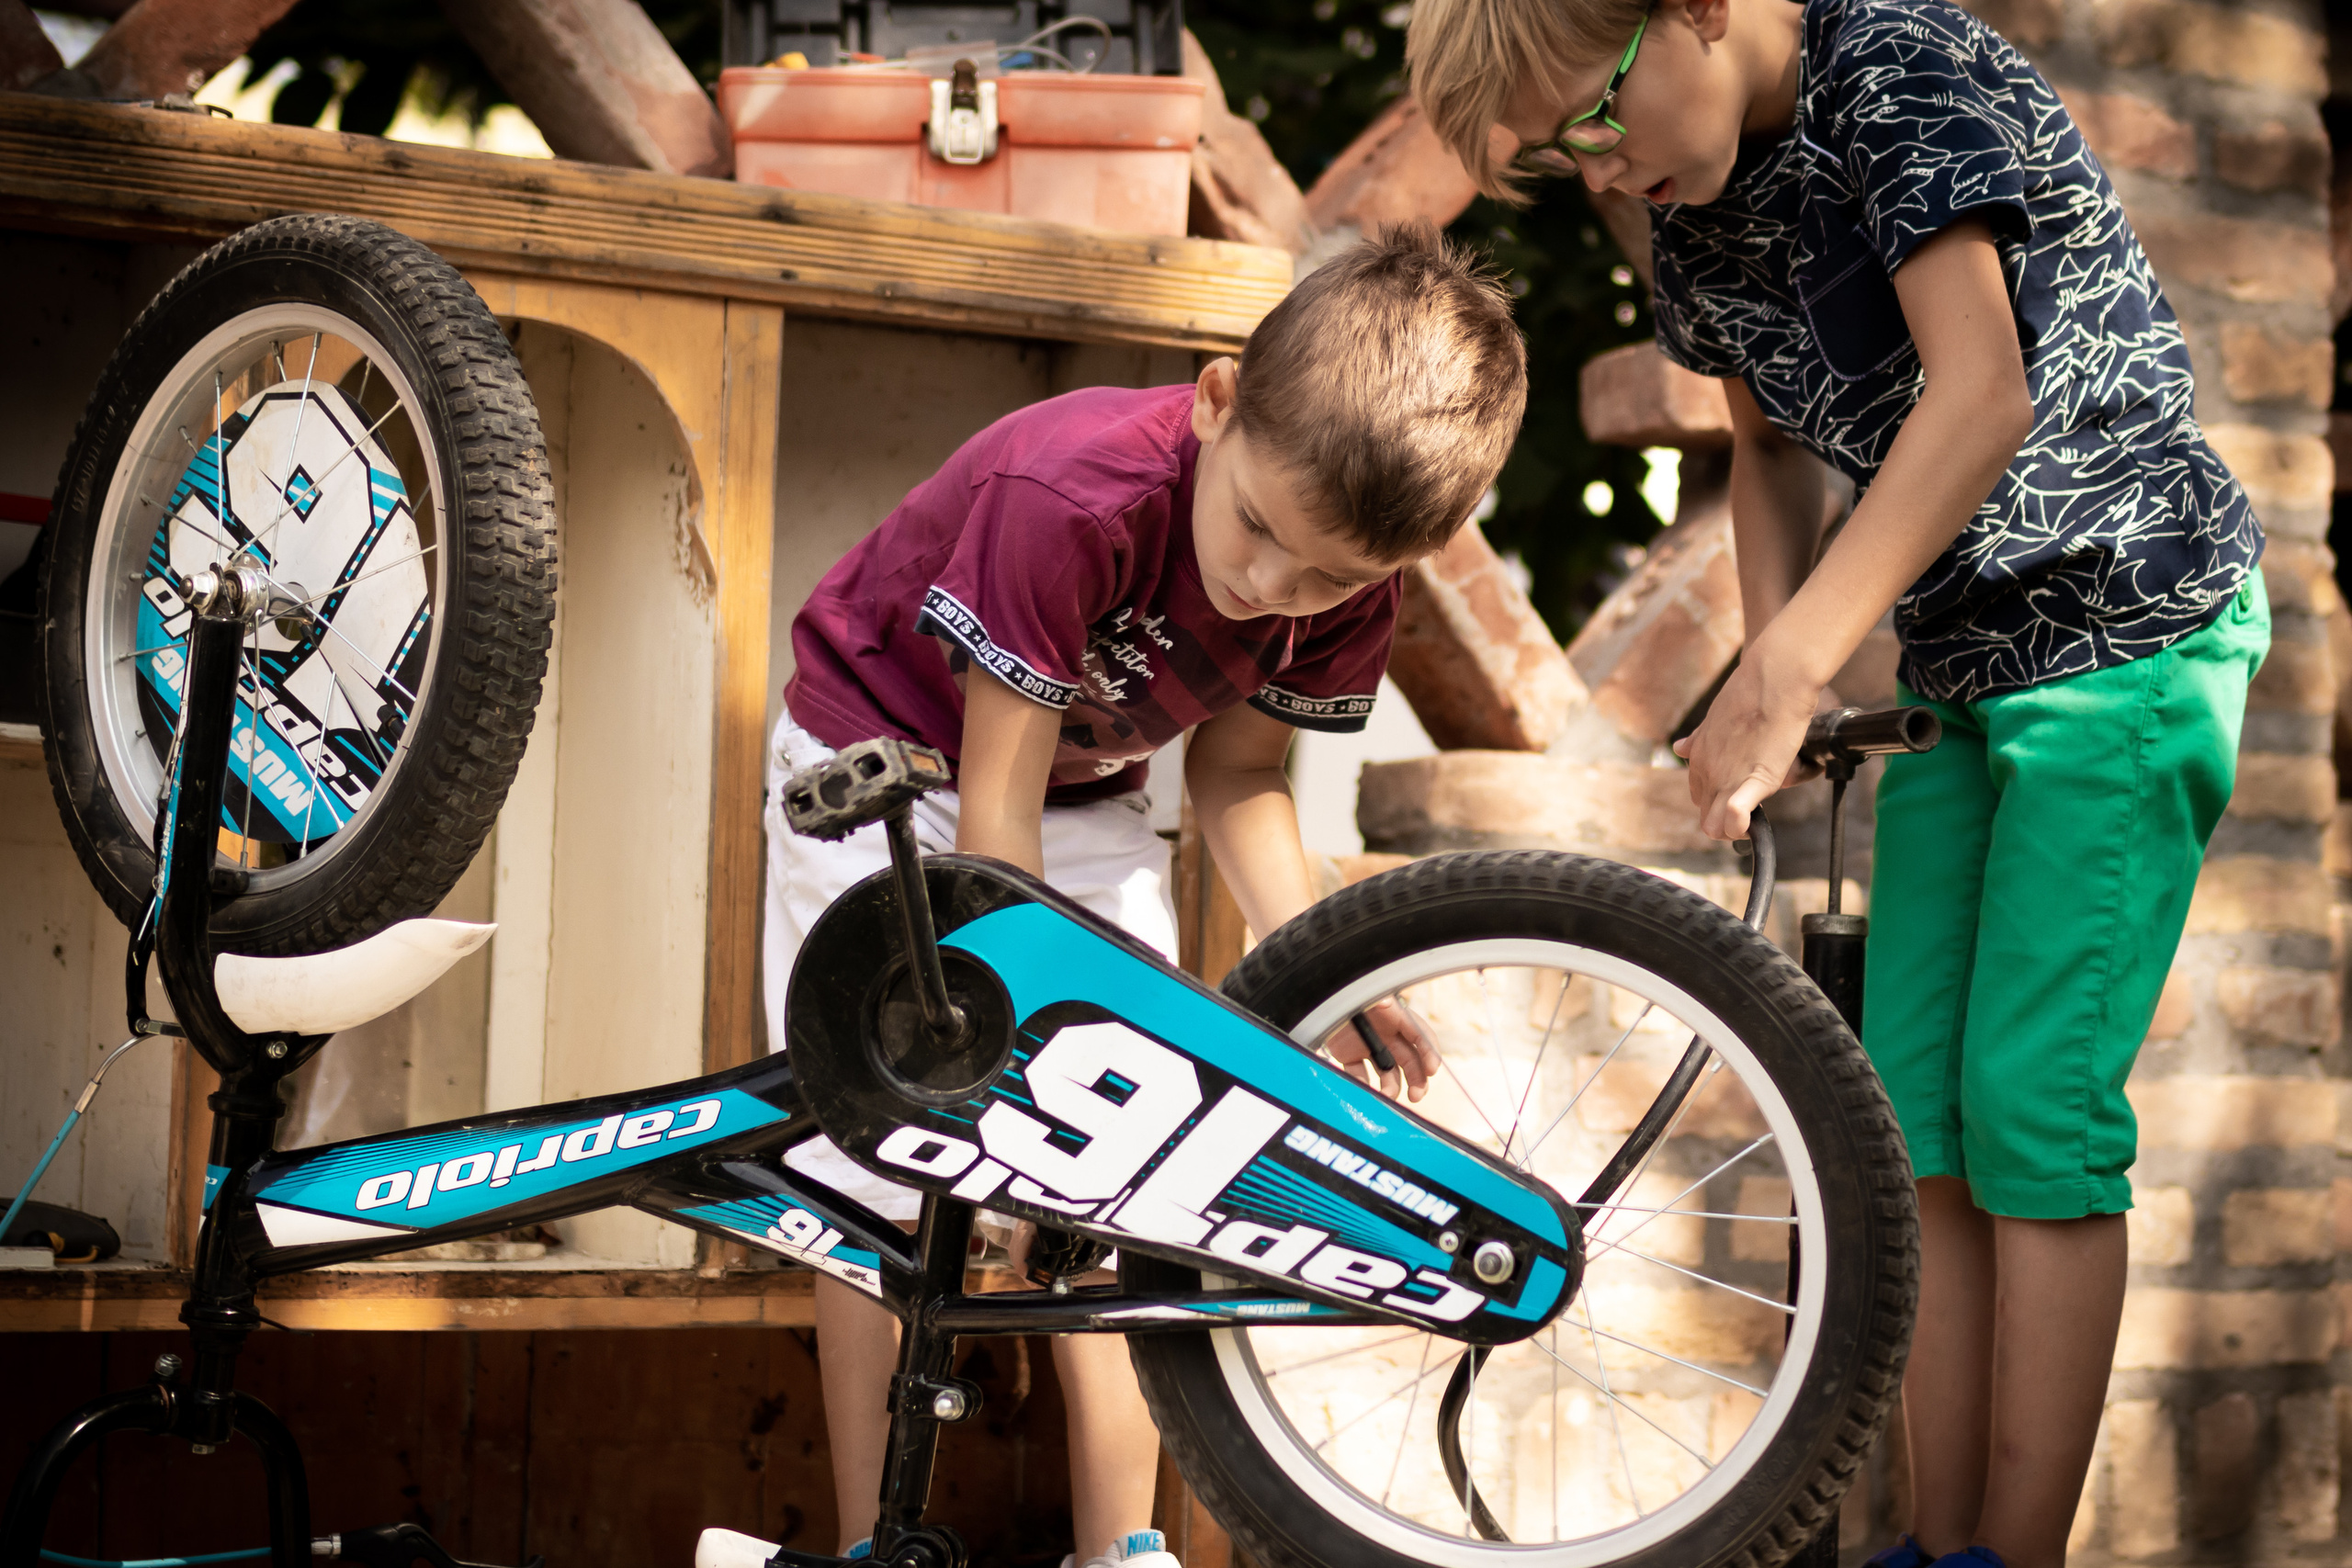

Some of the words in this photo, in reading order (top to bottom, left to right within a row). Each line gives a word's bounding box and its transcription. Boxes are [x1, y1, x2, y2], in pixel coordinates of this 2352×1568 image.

[935, 599, 975, 635] BOYS
[978, 639, 1015, 674] BOYS
[1021, 673, 1064, 702] BOYS
[1091, 671, 1128, 701] only
[1291, 699, 1336, 713] BOYS
[355, 1098, 722, 1212] capriolo
[977, 1021, 1291, 1246] 16
[1283, 1123, 1460, 1226] MUSTANG
[766, 1208, 844, 1266] 16
[1237, 1302, 1311, 1316] MUSTANG
[1126, 1531, 1161, 1557] NIKE
